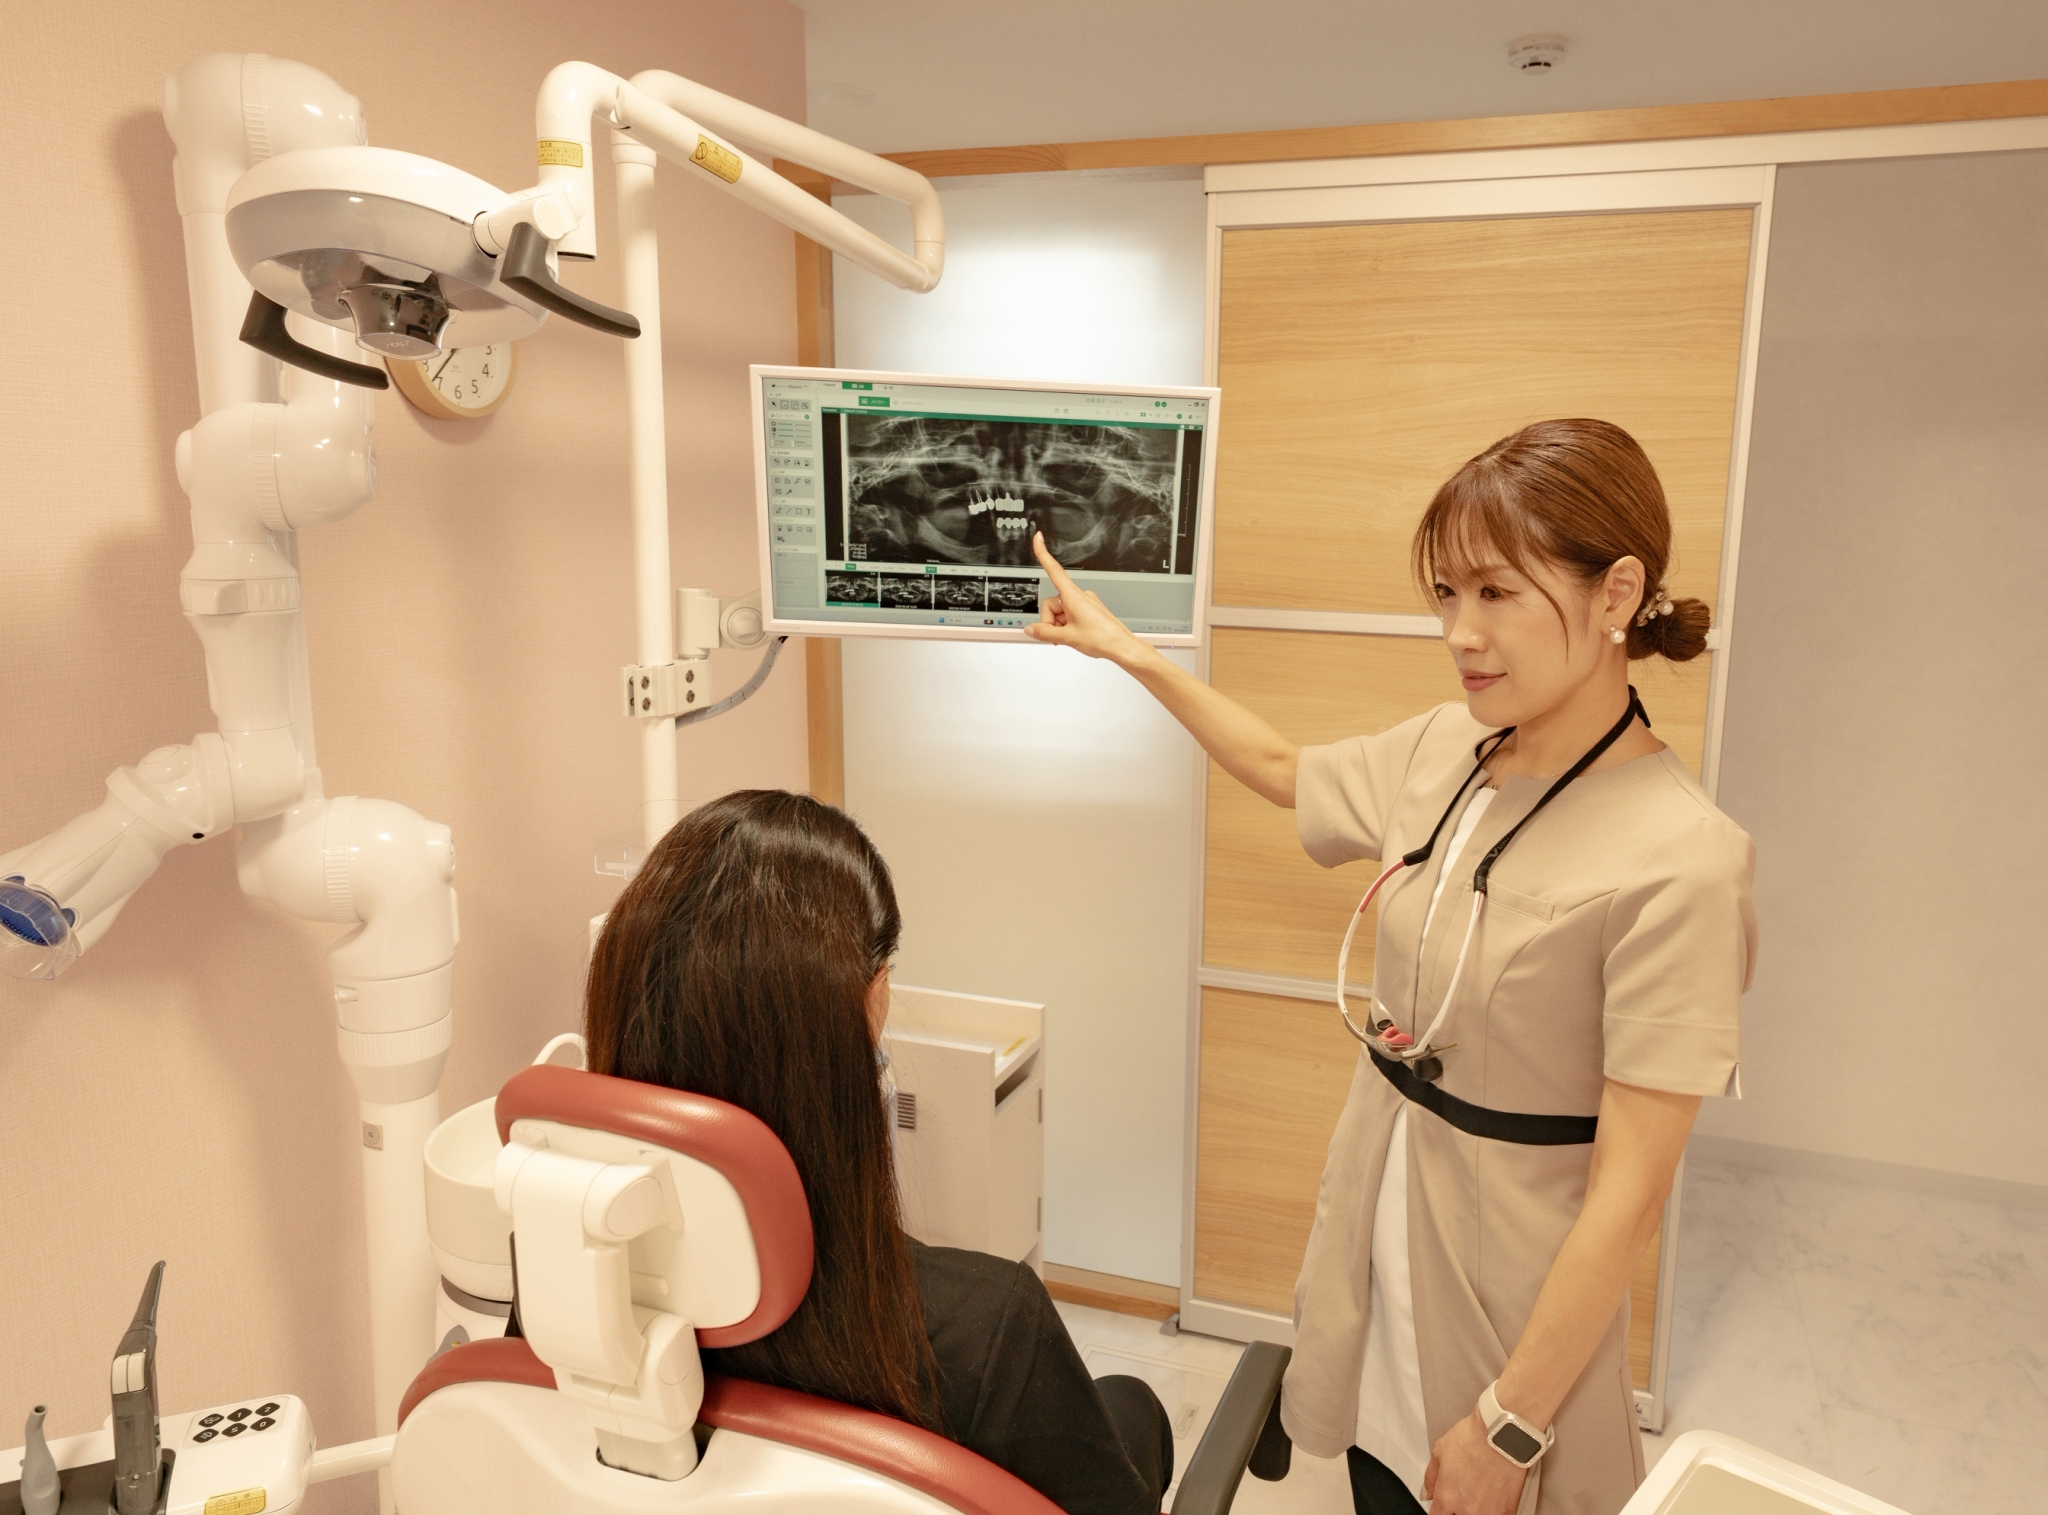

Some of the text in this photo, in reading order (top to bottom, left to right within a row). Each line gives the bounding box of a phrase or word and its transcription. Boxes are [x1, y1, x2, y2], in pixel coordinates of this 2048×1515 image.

[482, 363, 489, 378] 4
[435, 377, 443, 391] 7
[454, 384, 462, 399] 6
[471, 379, 479, 394] 5
[1162, 559, 1170, 569] L
